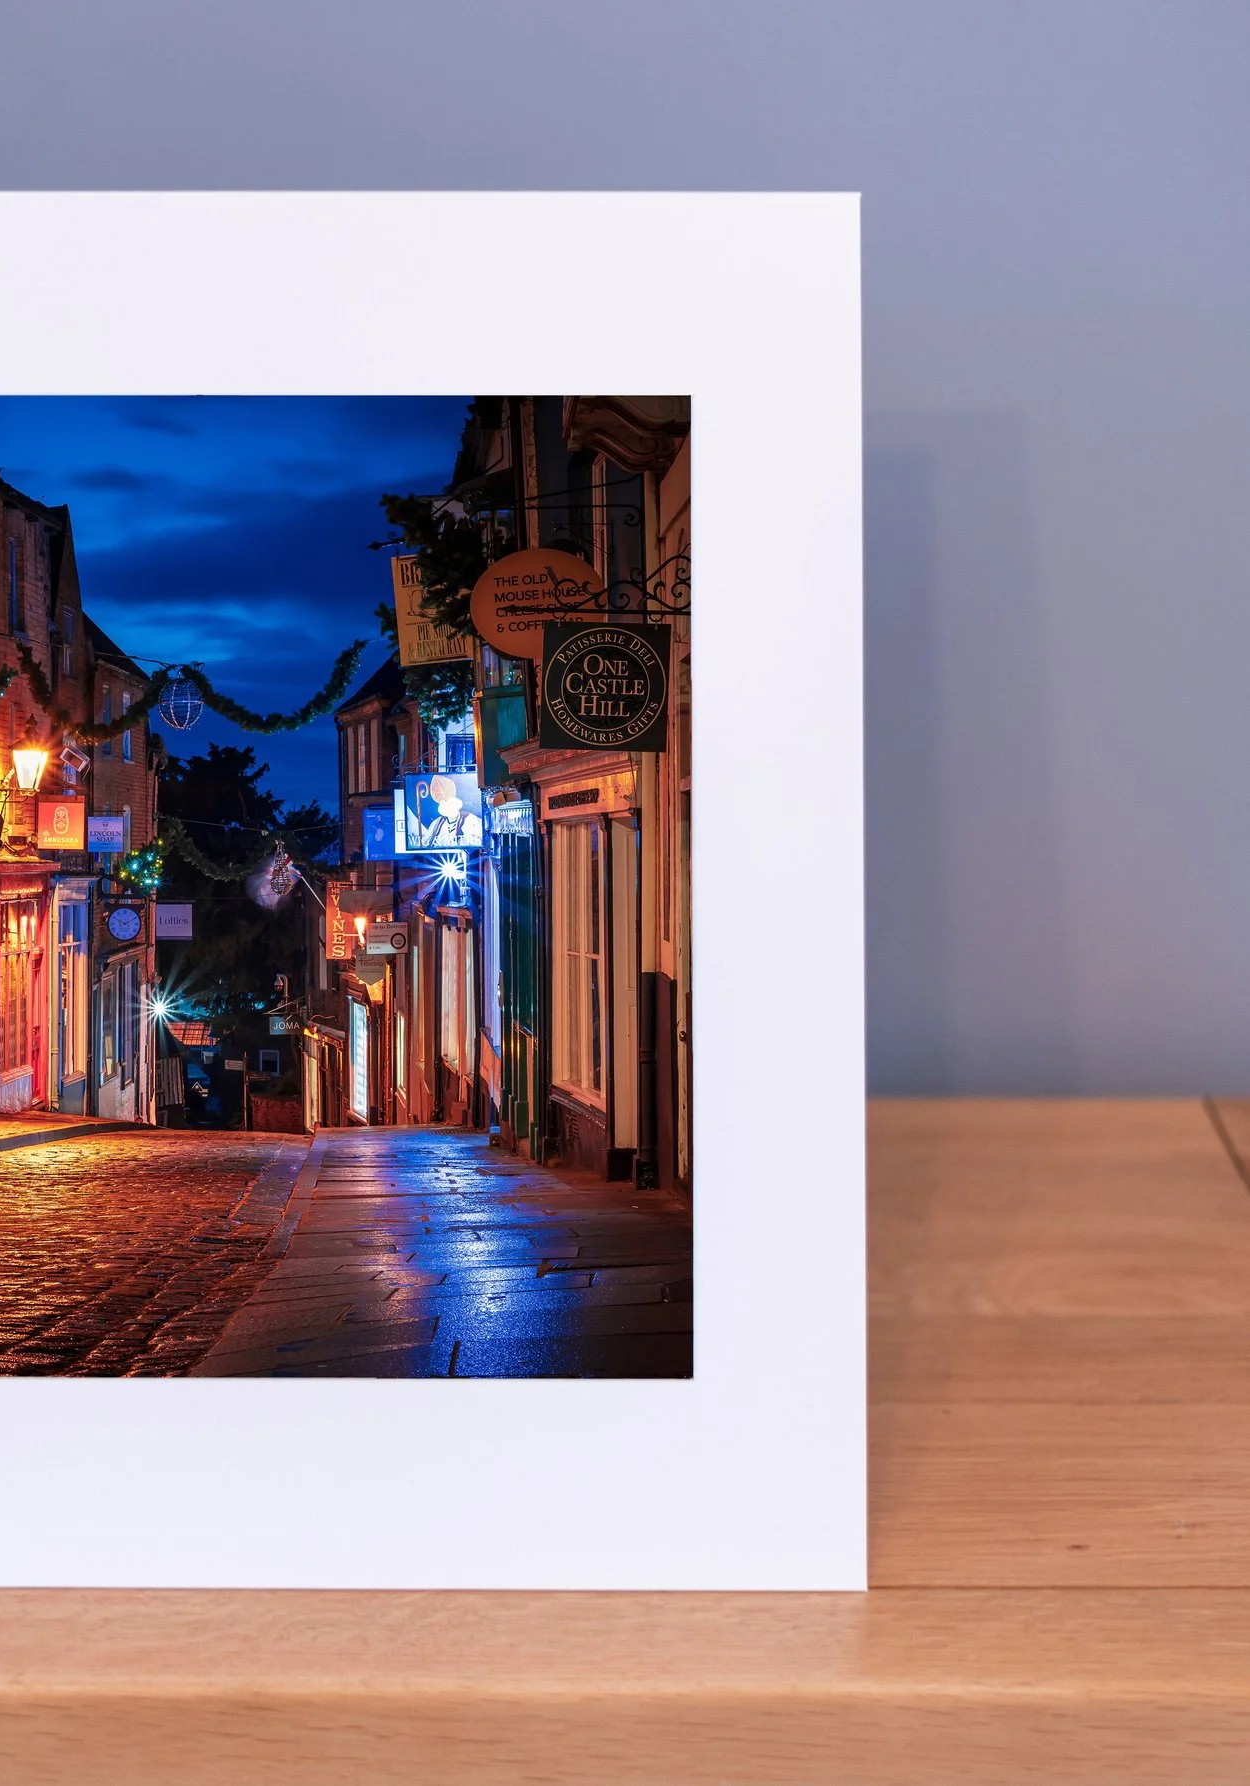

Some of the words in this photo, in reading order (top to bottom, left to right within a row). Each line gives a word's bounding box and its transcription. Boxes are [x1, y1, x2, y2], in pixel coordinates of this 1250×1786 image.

[494, 576, 519, 587] THE
[522, 574, 549, 585] OLD
[494, 589, 539, 603] MOUSE
[542, 586, 586, 599] HOUSE
[417, 624, 431, 641] PIE
[497, 623, 505, 633] &
[557, 633, 626, 664] PATISSERIE
[629, 638, 656, 667] DELI
[583, 653, 629, 676] ONE
[565, 672, 645, 695] CASTLE
[578, 694, 630, 717] HILL
[551, 698, 624, 742] HOMEWARES
[627, 701, 659, 735] GIFTS
[331, 894, 346, 958] VINES
[273, 1021, 300, 1030] JOMA
